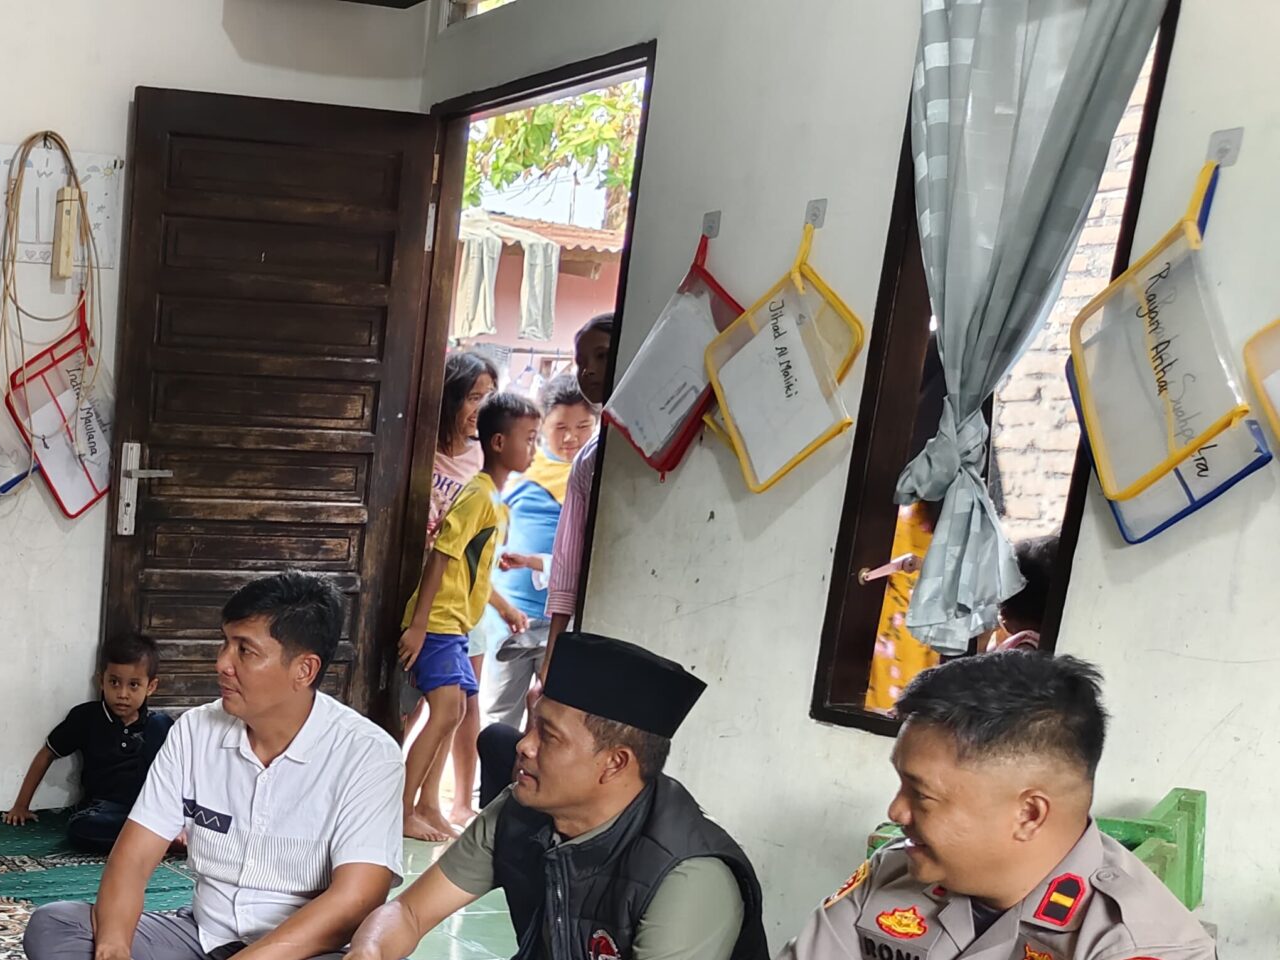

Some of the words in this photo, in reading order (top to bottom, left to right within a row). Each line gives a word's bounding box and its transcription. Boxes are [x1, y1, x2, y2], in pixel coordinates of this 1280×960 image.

[768, 299, 786, 340] Jihad
[775, 346, 788, 359] Al
[778, 359, 800, 399] Maliki
